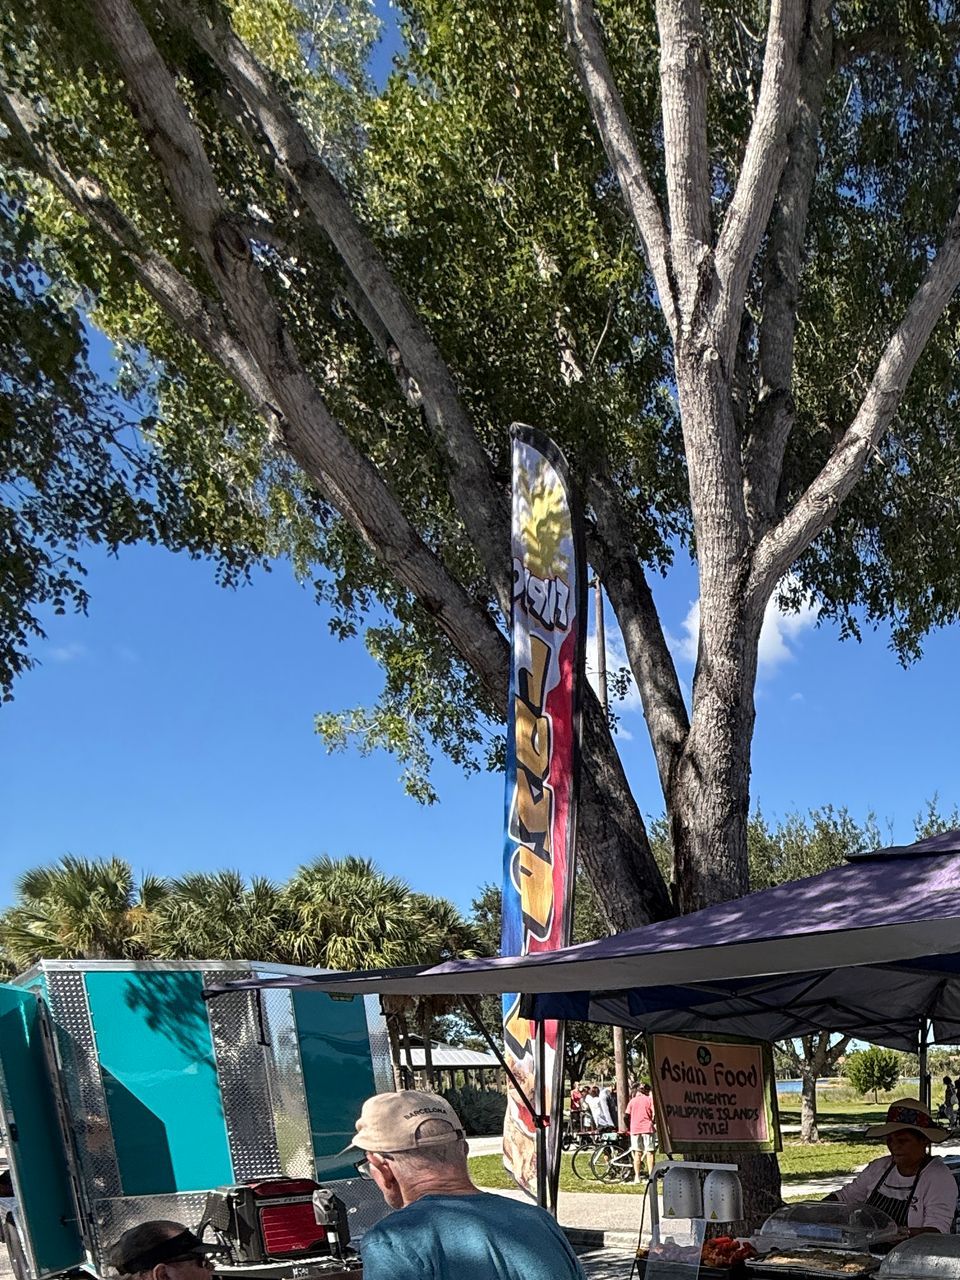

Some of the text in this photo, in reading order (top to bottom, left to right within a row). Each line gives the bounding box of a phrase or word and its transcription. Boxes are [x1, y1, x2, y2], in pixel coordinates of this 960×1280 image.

[661, 1056, 757, 1088] Asian Food
[684, 1090, 737, 1106] AUTHENTIC
[403, 1107, 447, 1120] BARCELONA
[666, 1104, 760, 1122] PHILIPPINE ISLANDS
[697, 1121, 729, 1135] STYLE!
